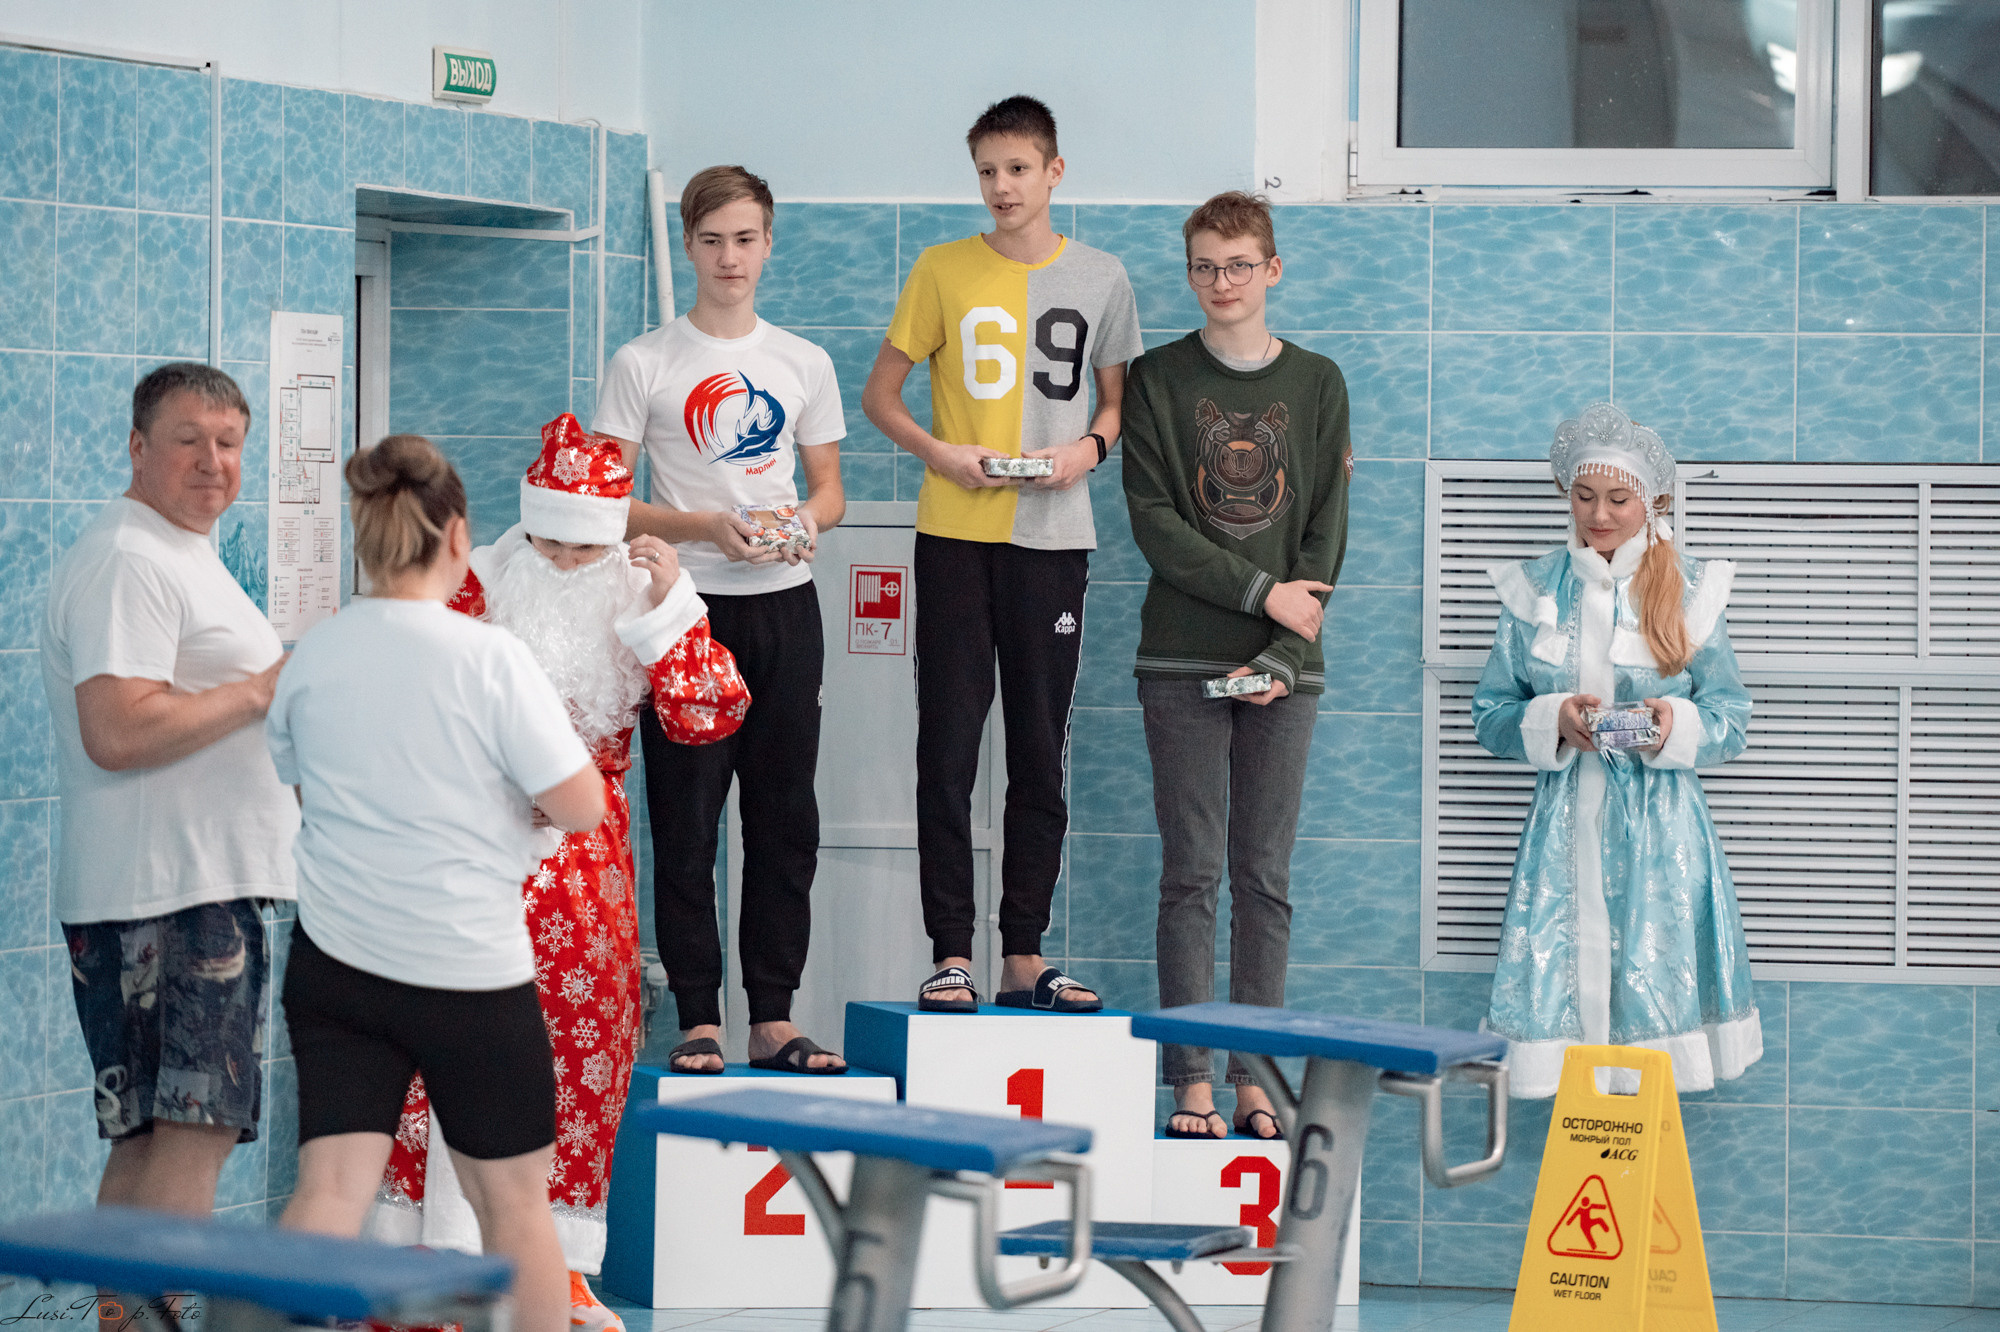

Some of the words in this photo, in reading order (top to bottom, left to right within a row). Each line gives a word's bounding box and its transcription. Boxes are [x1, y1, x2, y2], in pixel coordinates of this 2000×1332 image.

[449, 58, 492, 92] ВЫХОД
[745, 457, 777, 476] Марлин
[1054, 624, 1076, 635] Kappa
[923, 975, 966, 991] PUMA
[1562, 1117, 1643, 1134] ОСТОРОЖНО
[1612, 1136, 1631, 1146] ПОЛ
[1609, 1149, 1639, 1161] ACG
[1289, 1123, 1334, 1220] 6
[744, 1141, 805, 1236] 2
[1220, 1155, 1281, 1276] 3
[1549, 1271, 1610, 1289] CAUTION
[1553, 1289, 1572, 1298] WET
[1575, 1290, 1602, 1301] FLOOR
